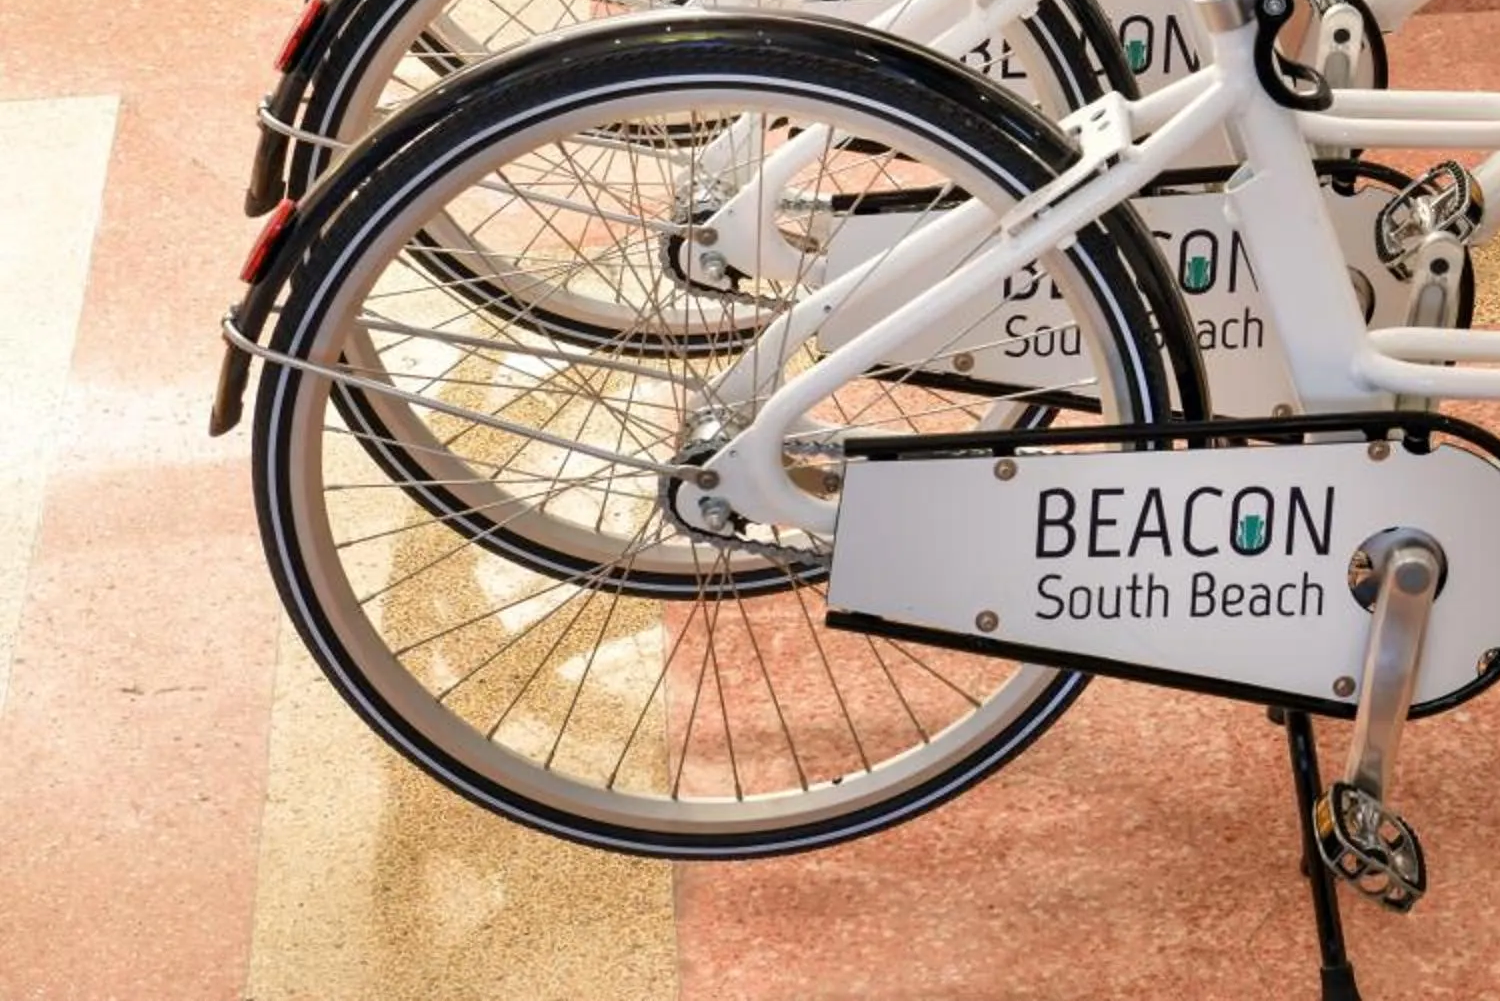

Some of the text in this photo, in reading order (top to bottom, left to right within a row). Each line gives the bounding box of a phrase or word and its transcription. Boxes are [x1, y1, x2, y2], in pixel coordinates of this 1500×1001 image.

[1003, 229, 1259, 300] BON
[1004, 307, 1263, 358] Sou ach
[1035, 486, 1335, 559] BEACON
[1035, 571, 1324, 620] South Beach
